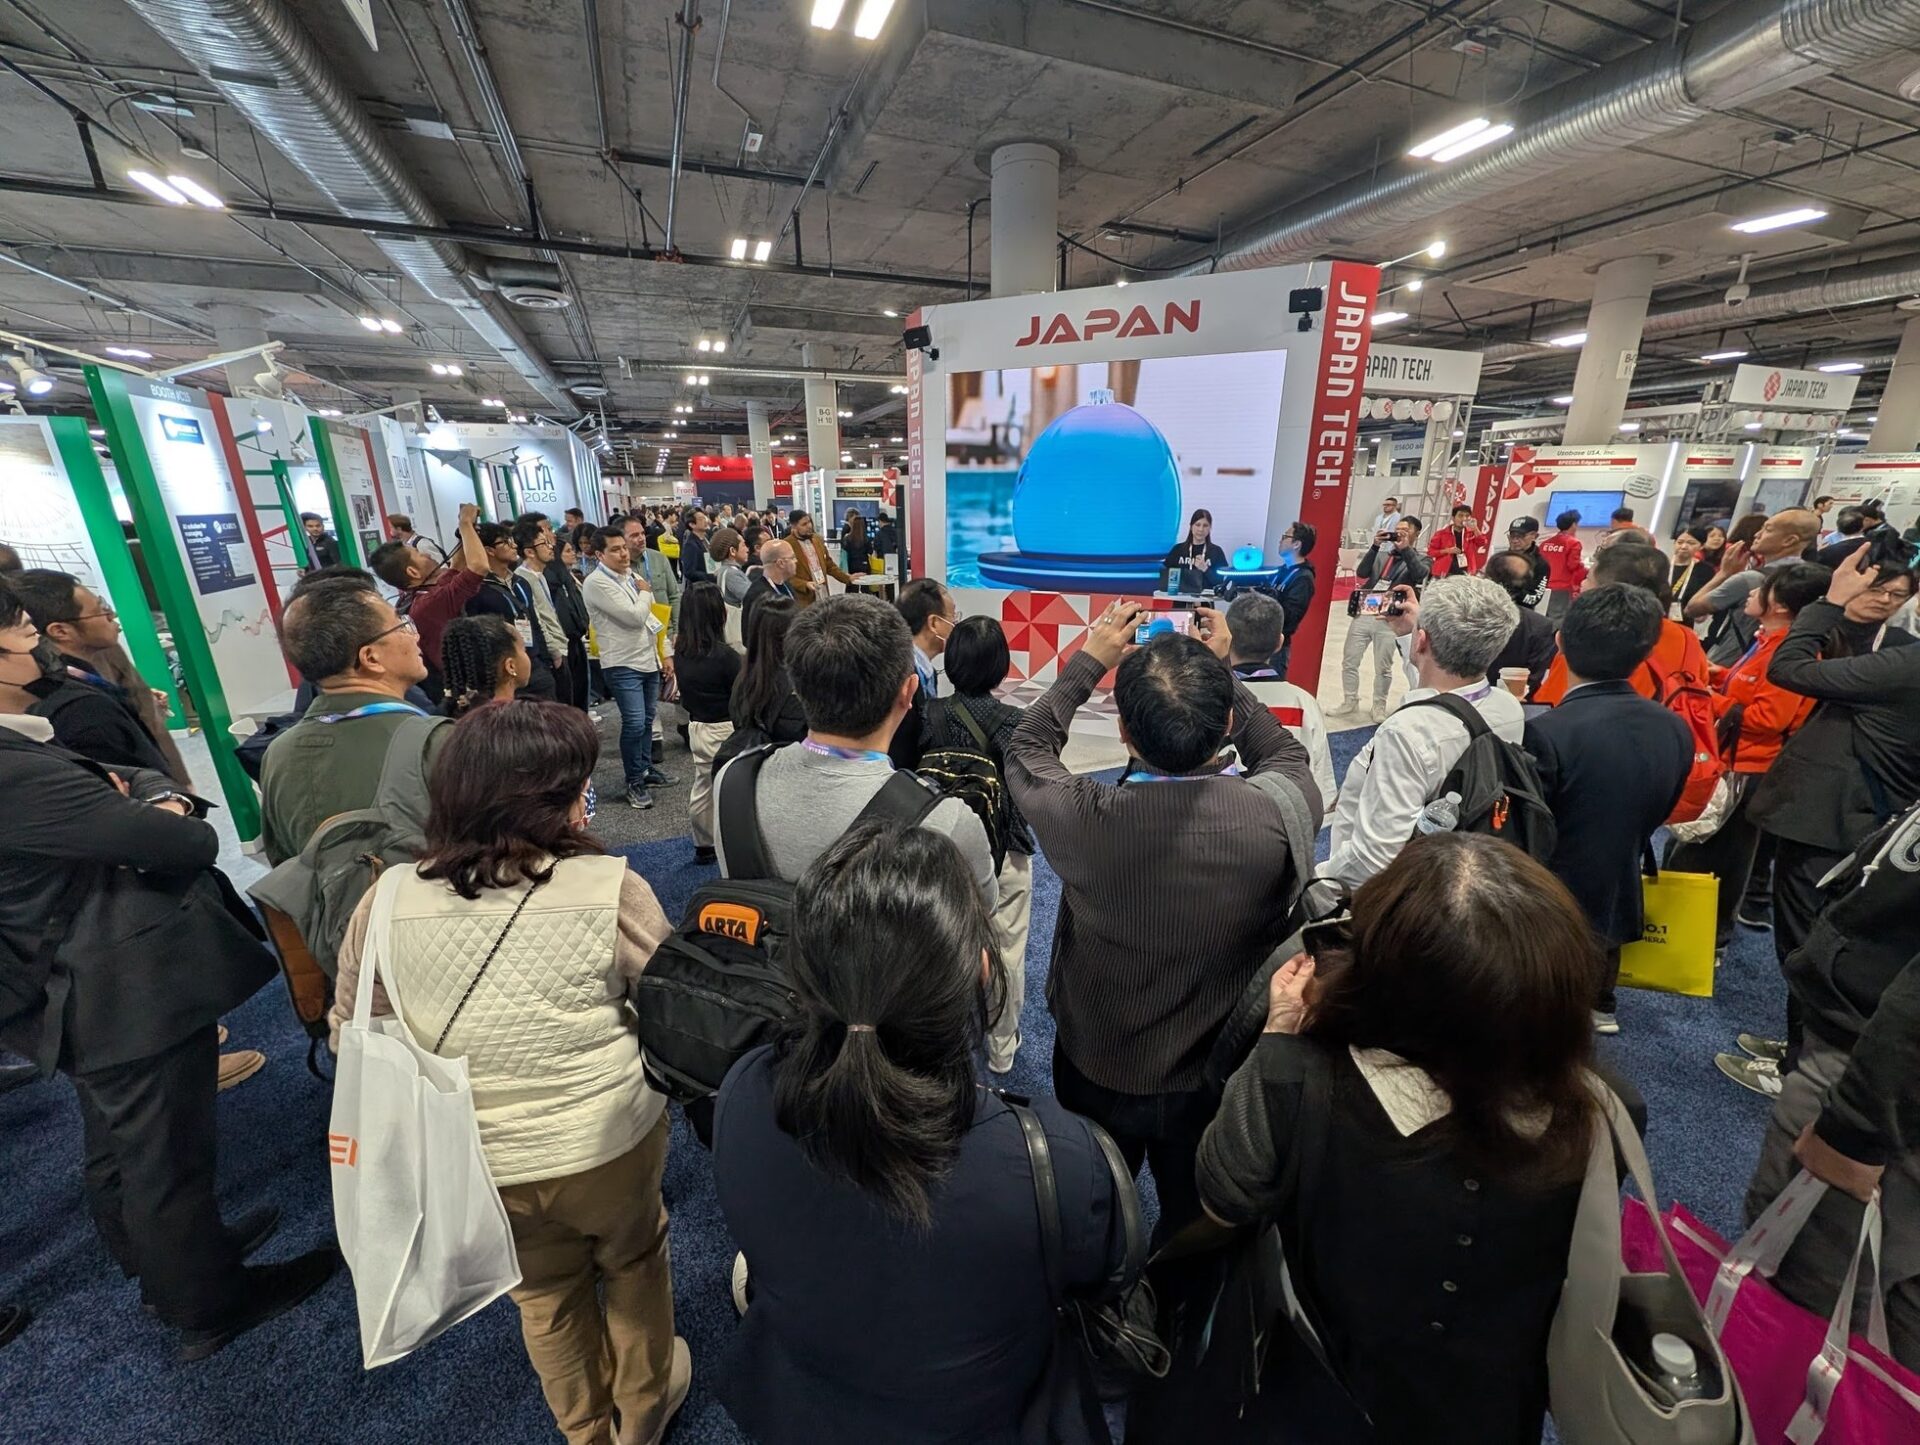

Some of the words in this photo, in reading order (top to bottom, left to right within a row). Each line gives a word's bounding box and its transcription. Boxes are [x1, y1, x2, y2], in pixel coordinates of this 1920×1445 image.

[1015, 300, 1201, 347] JAPAN
[1326, 281, 1367, 397] JAPAN
[1366, 355, 1398, 379] APAN
[1402, 357, 1433, 381] TECH
[150, 384, 176, 400] BOOTH
[911, 347, 921, 418] APAN
[1780, 378, 1809, 398] JAPAN
[1808, 380, 1829, 399] TECH
[911, 426, 922, 489] TECH
[525, 492, 557, 503] 2026
[1542, 545, 1564, 553] EDGE
[704, 916, 749, 940] ARTA
